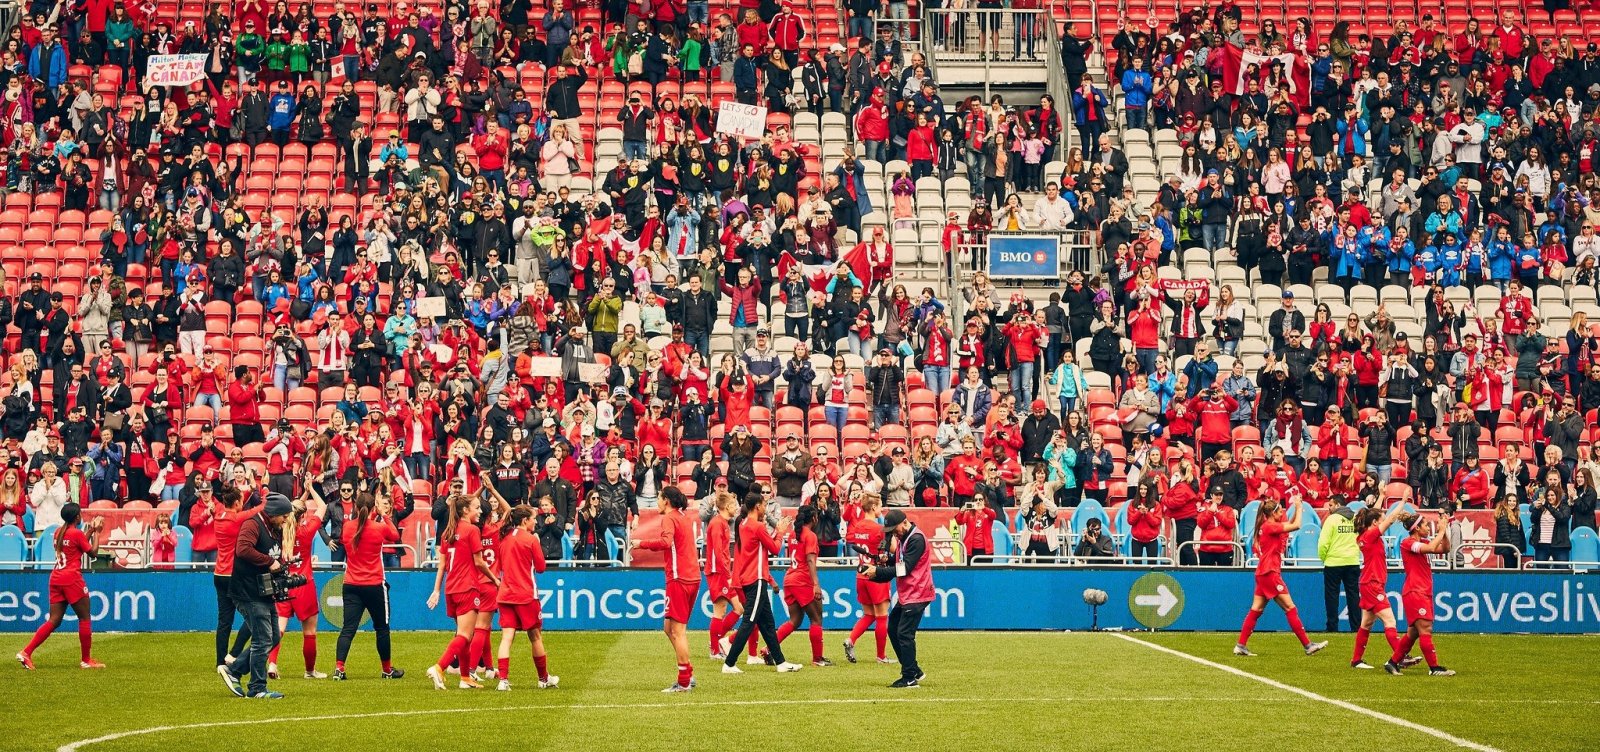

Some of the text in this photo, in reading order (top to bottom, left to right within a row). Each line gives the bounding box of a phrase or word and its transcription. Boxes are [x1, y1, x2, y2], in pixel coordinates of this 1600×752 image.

[169, 61, 204, 70] TEAM
[744, 106, 758, 116] GO
[1000, 252, 1031, 262] BMO
[1163, 280, 1207, 289] CANADA
[108, 540, 144, 548] CANA
[447, 547, 456, 570] 7
